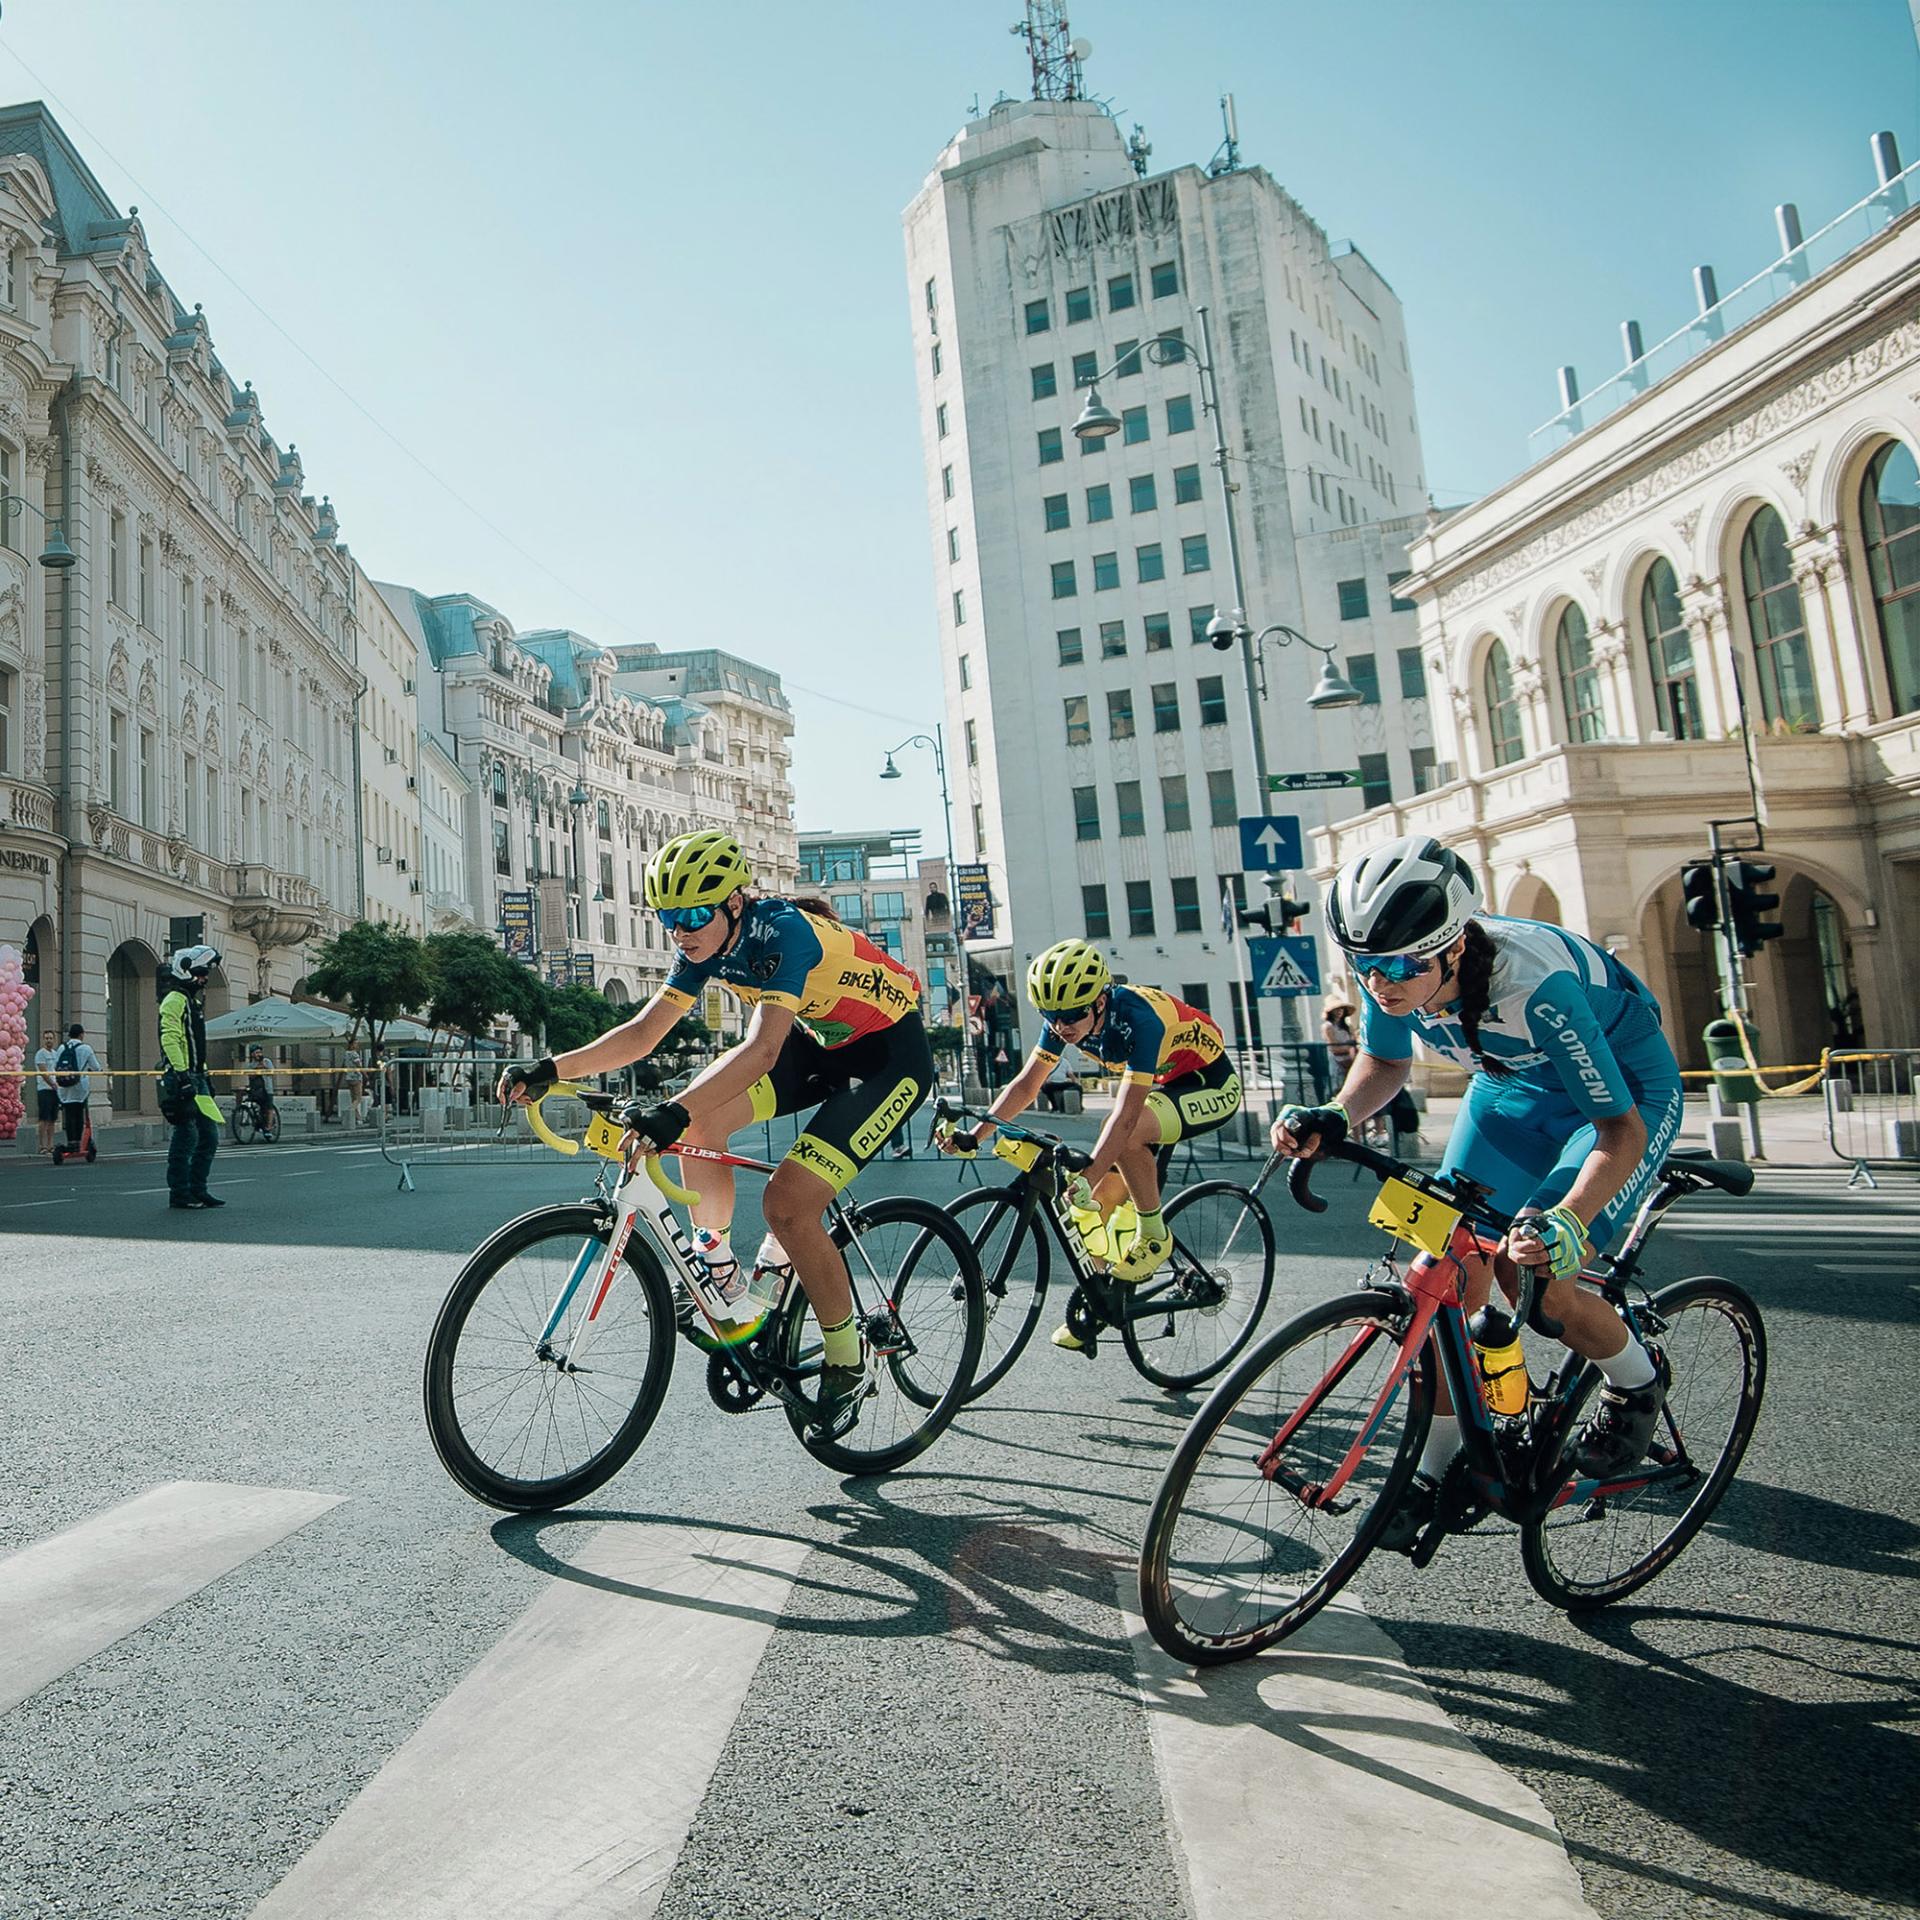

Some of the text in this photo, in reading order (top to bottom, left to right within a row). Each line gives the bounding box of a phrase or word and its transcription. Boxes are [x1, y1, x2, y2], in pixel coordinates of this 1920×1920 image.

[1417, 918, 1460, 949] RUDY
[858, 1086, 913, 1151] PLUTON
[1187, 1081, 1240, 1118] PLUTON
[601, 1129, 609, 1145] 8
[682, 1145, 723, 1160] CUBE
[1604, 1158, 1651, 1220] CLUBUL
[1406, 1201, 1424, 1225] 3
[609, 1222, 634, 1273] CUBE
[658, 1207, 724, 1306] CUBE
[1051, 1196, 1097, 1279] CUBE
